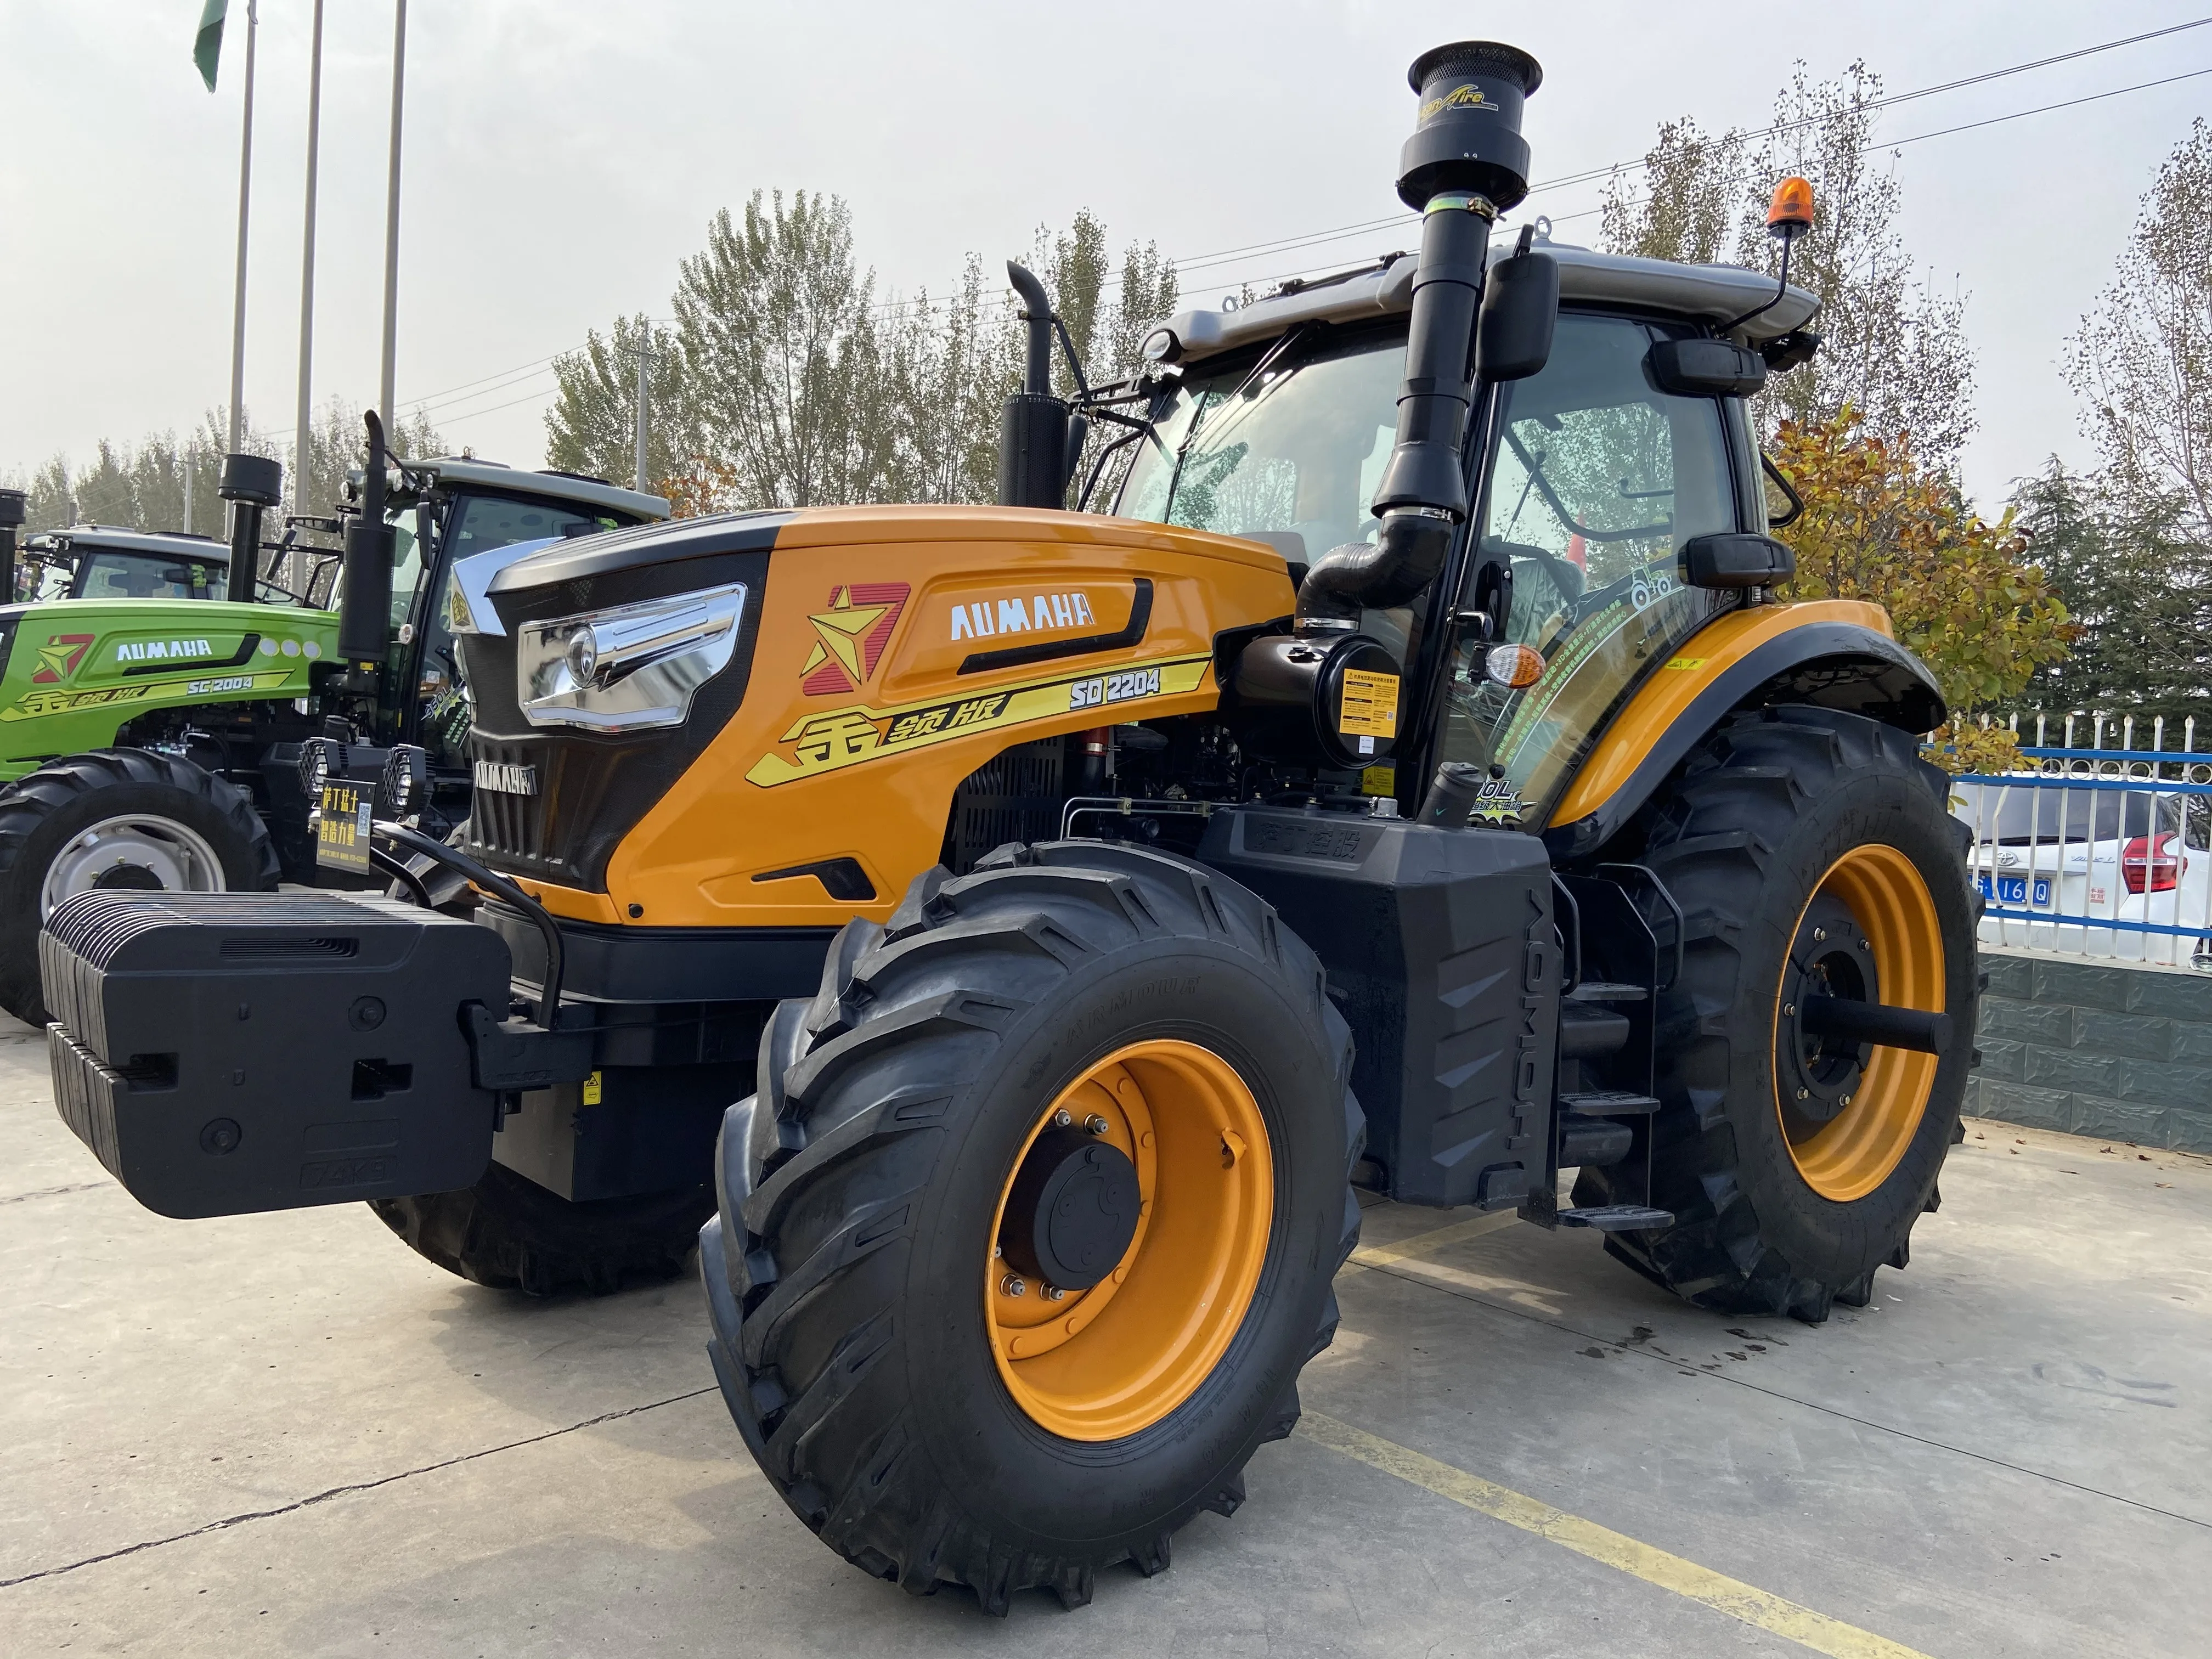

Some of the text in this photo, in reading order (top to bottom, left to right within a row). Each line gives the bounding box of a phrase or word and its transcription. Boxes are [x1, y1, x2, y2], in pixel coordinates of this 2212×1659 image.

[187, 675, 254, 696] SC 2004
[1070, 668, 1160, 710] SD 2204
[1066, 976, 1201, 1046] ARMOUR
